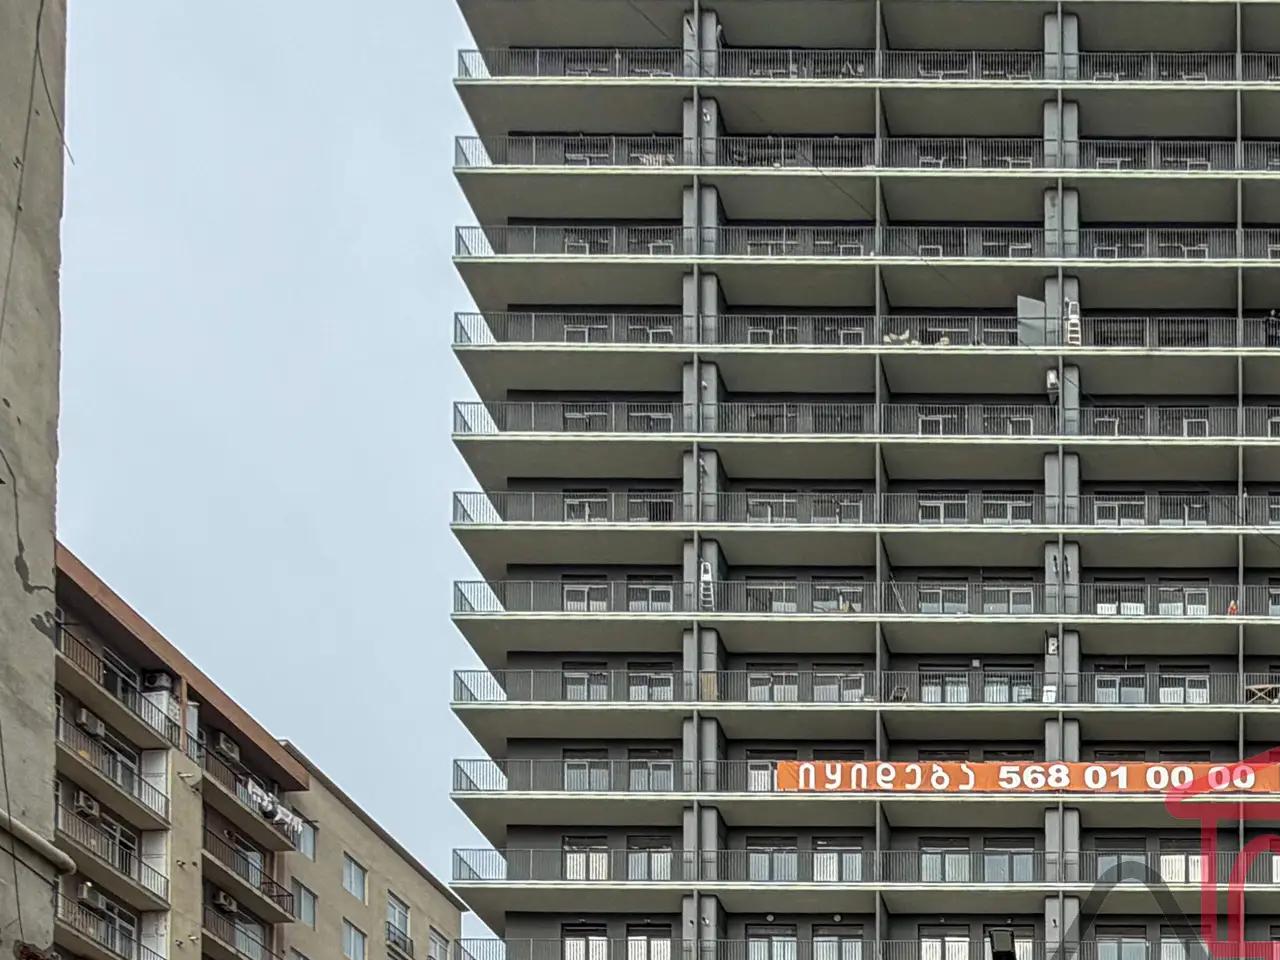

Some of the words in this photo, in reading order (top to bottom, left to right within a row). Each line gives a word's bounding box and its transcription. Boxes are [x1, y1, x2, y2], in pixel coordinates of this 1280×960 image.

[799, 762, 975, 790] იყიდება
[998, 764, 1070, 789] 568
[1084, 765, 1128, 789] 01
[1145, 766, 1193, 790] 00
[1207, 766, 1256, 790] 00
